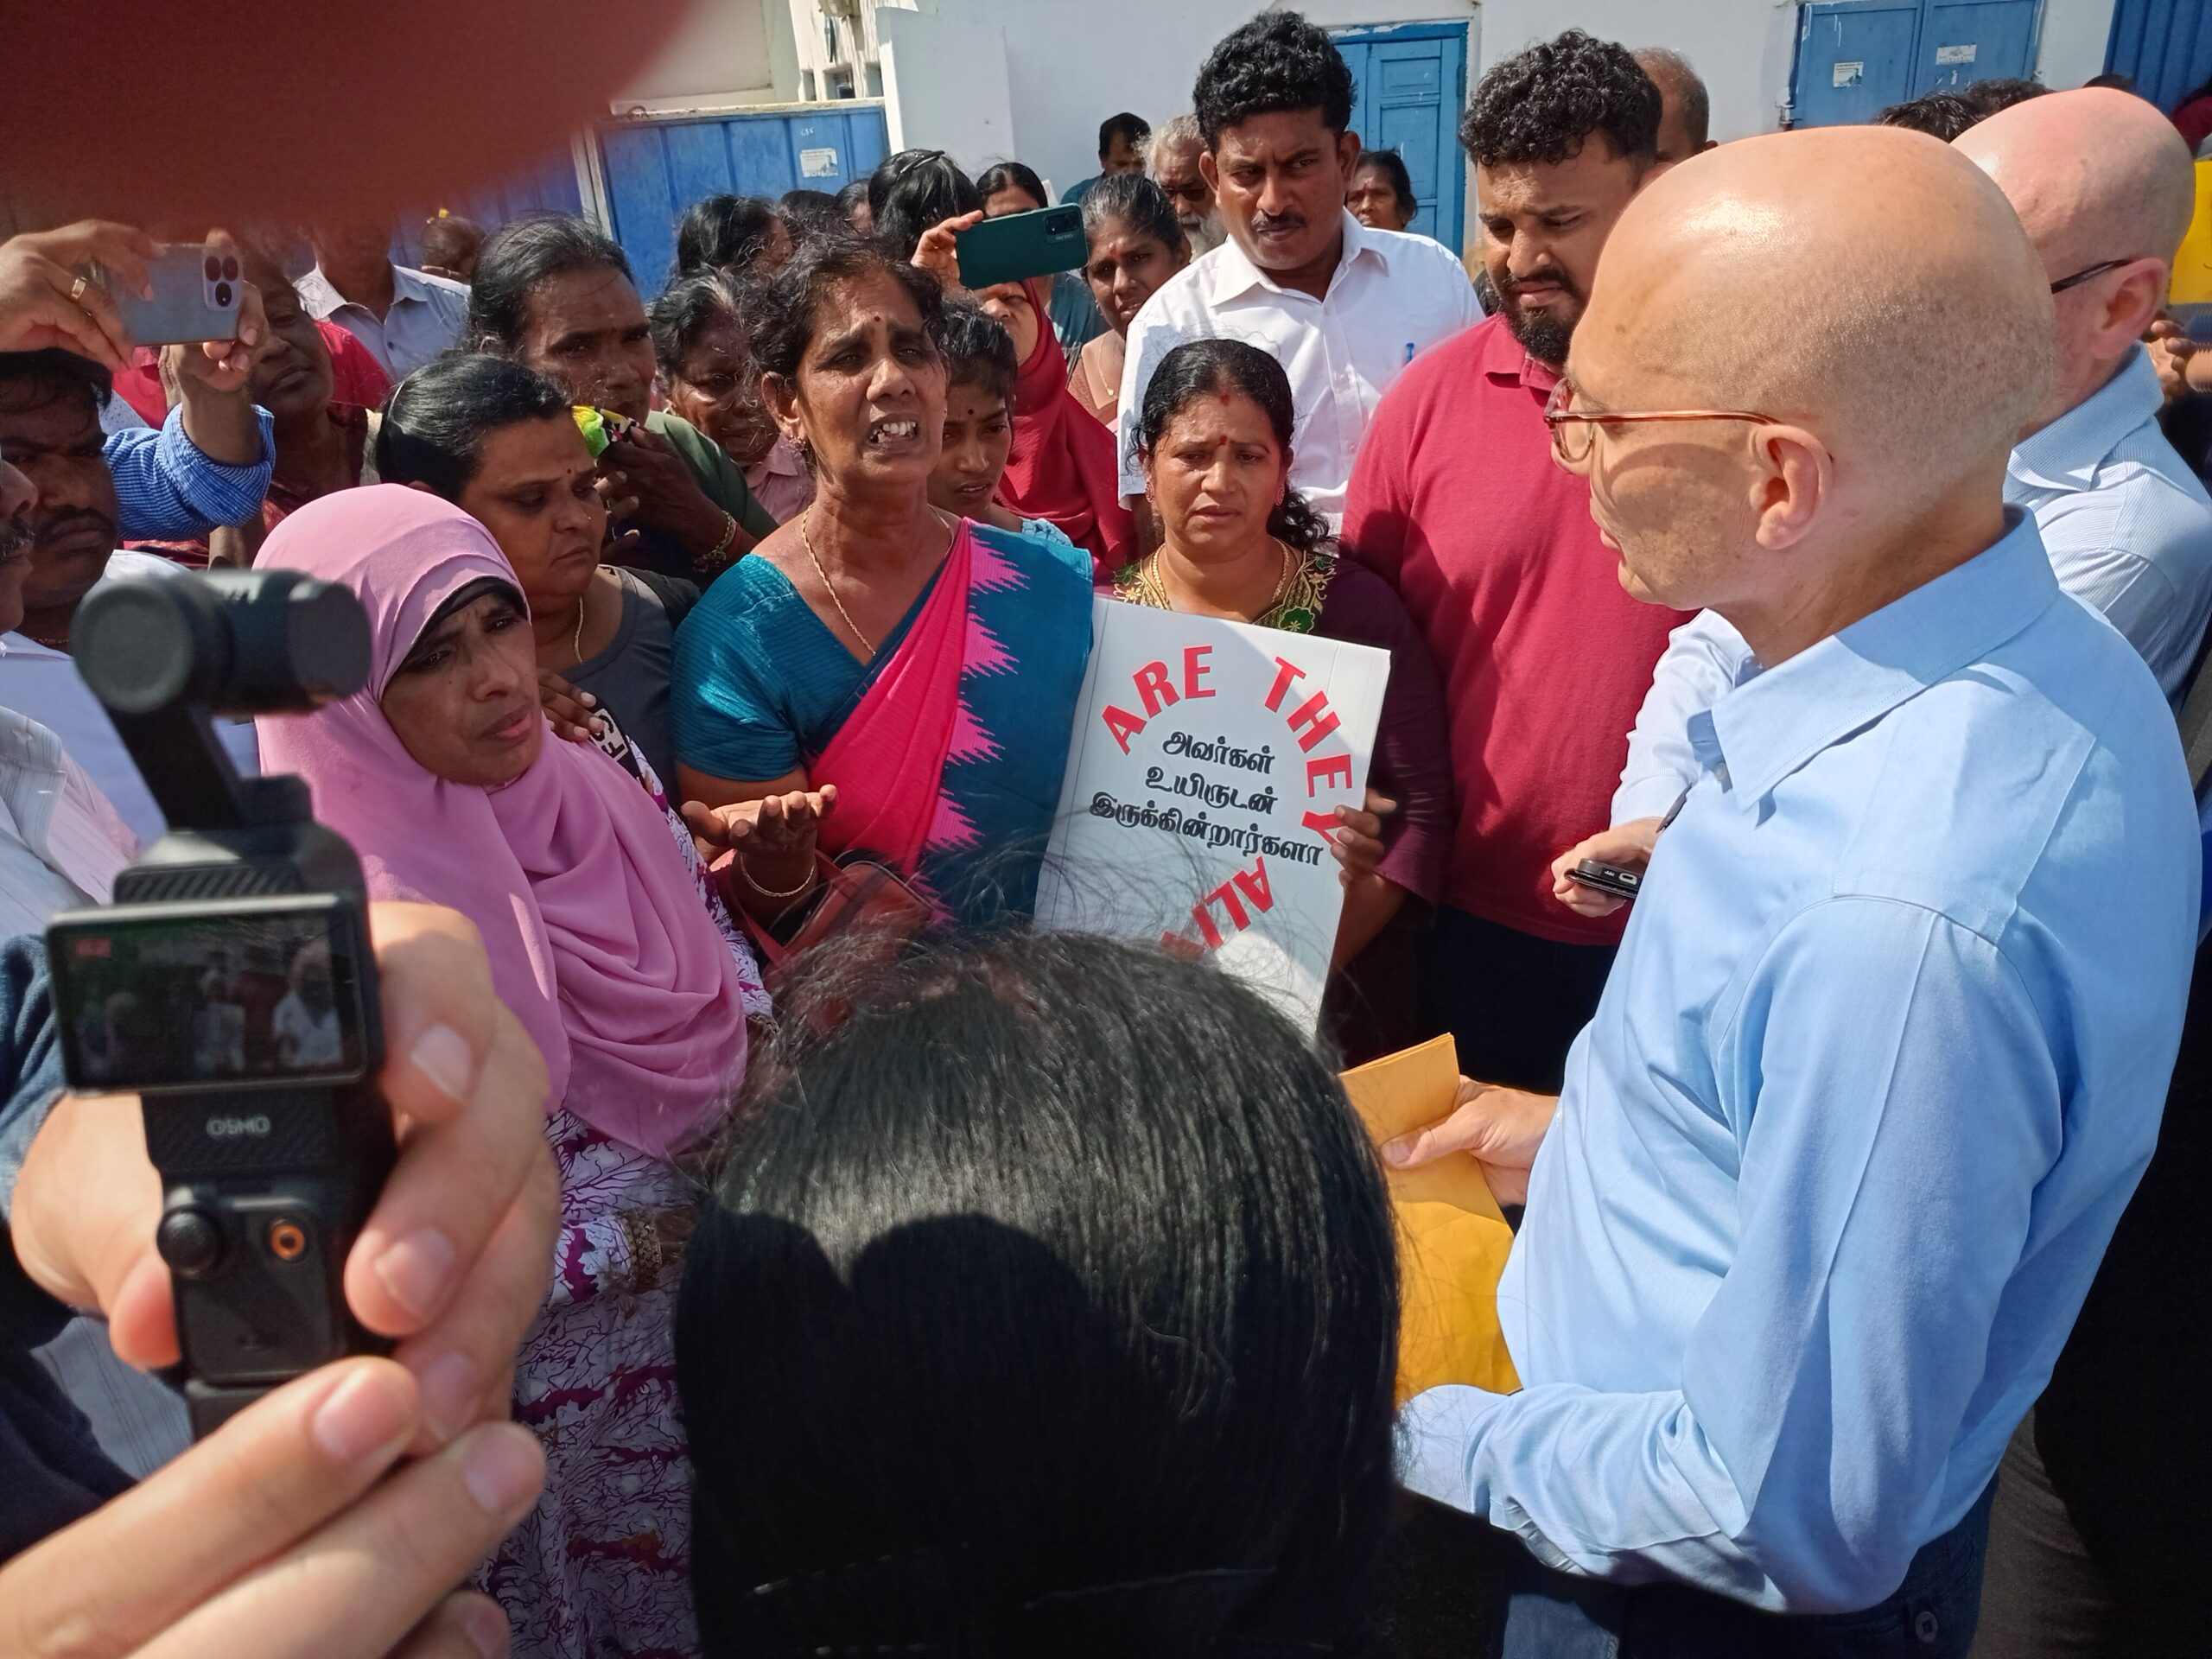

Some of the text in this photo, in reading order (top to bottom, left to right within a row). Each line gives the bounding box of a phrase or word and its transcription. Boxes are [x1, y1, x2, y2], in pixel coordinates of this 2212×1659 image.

[1102, 645, 1216, 754] ARE
[1265, 657, 1353, 844] THEY
[1162, 731, 1275, 774] அவர்கள்
[1145, 766, 1278, 815] உயிருடன்
[1089, 791, 1324, 866] இருக்கின்றார்களா
[207, 1116, 270, 1135] OSMO
